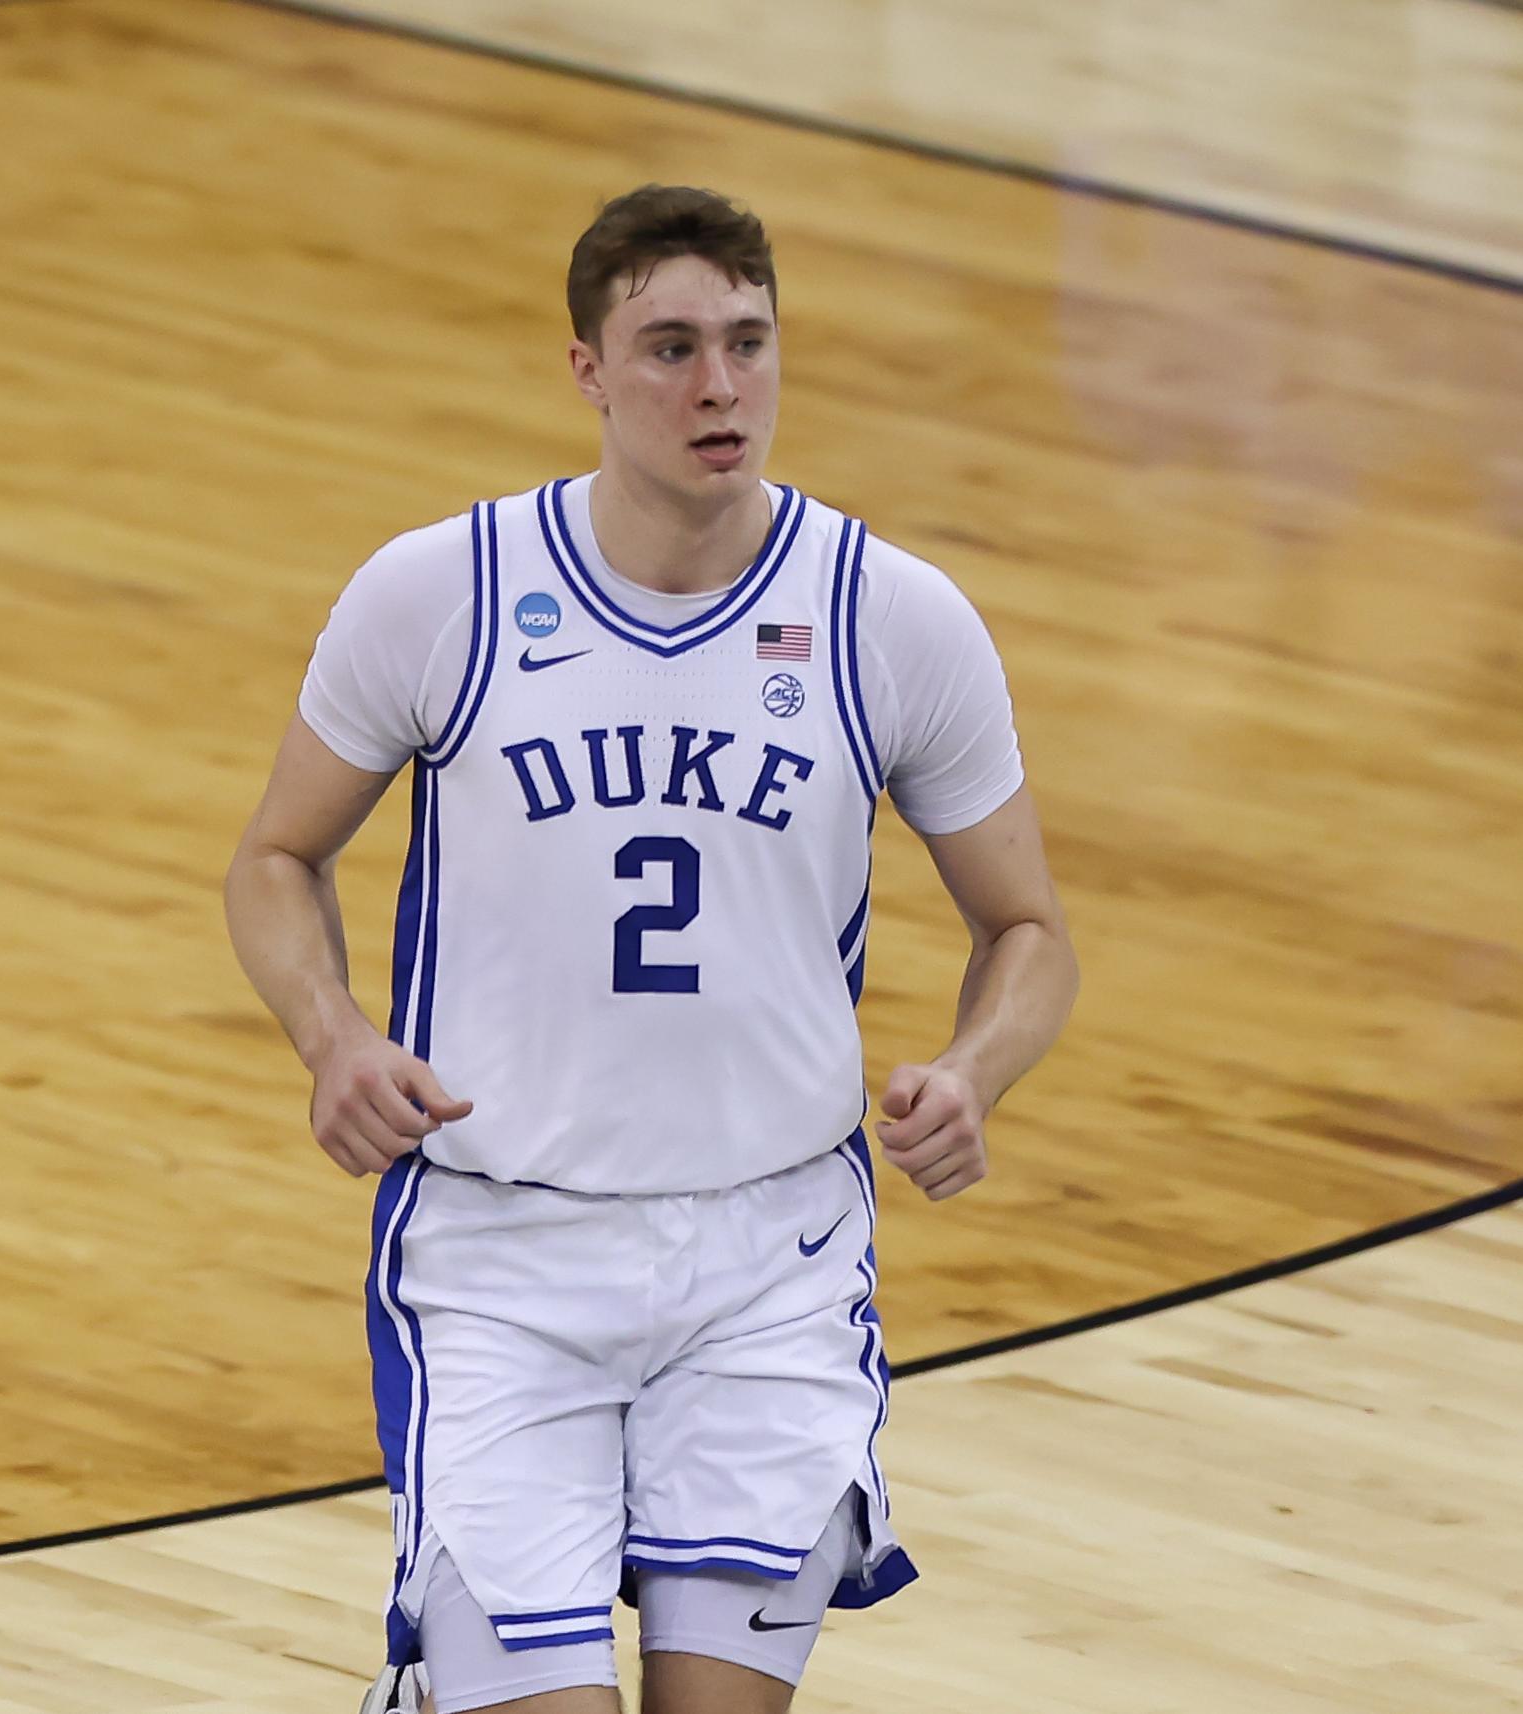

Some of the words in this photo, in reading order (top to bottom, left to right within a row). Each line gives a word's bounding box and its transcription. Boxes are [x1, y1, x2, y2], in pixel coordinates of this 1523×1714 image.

[520, 612, 558, 627] NCAA
[500, 725, 815, 831] DUKE
[613, 836, 700, 994] 2
